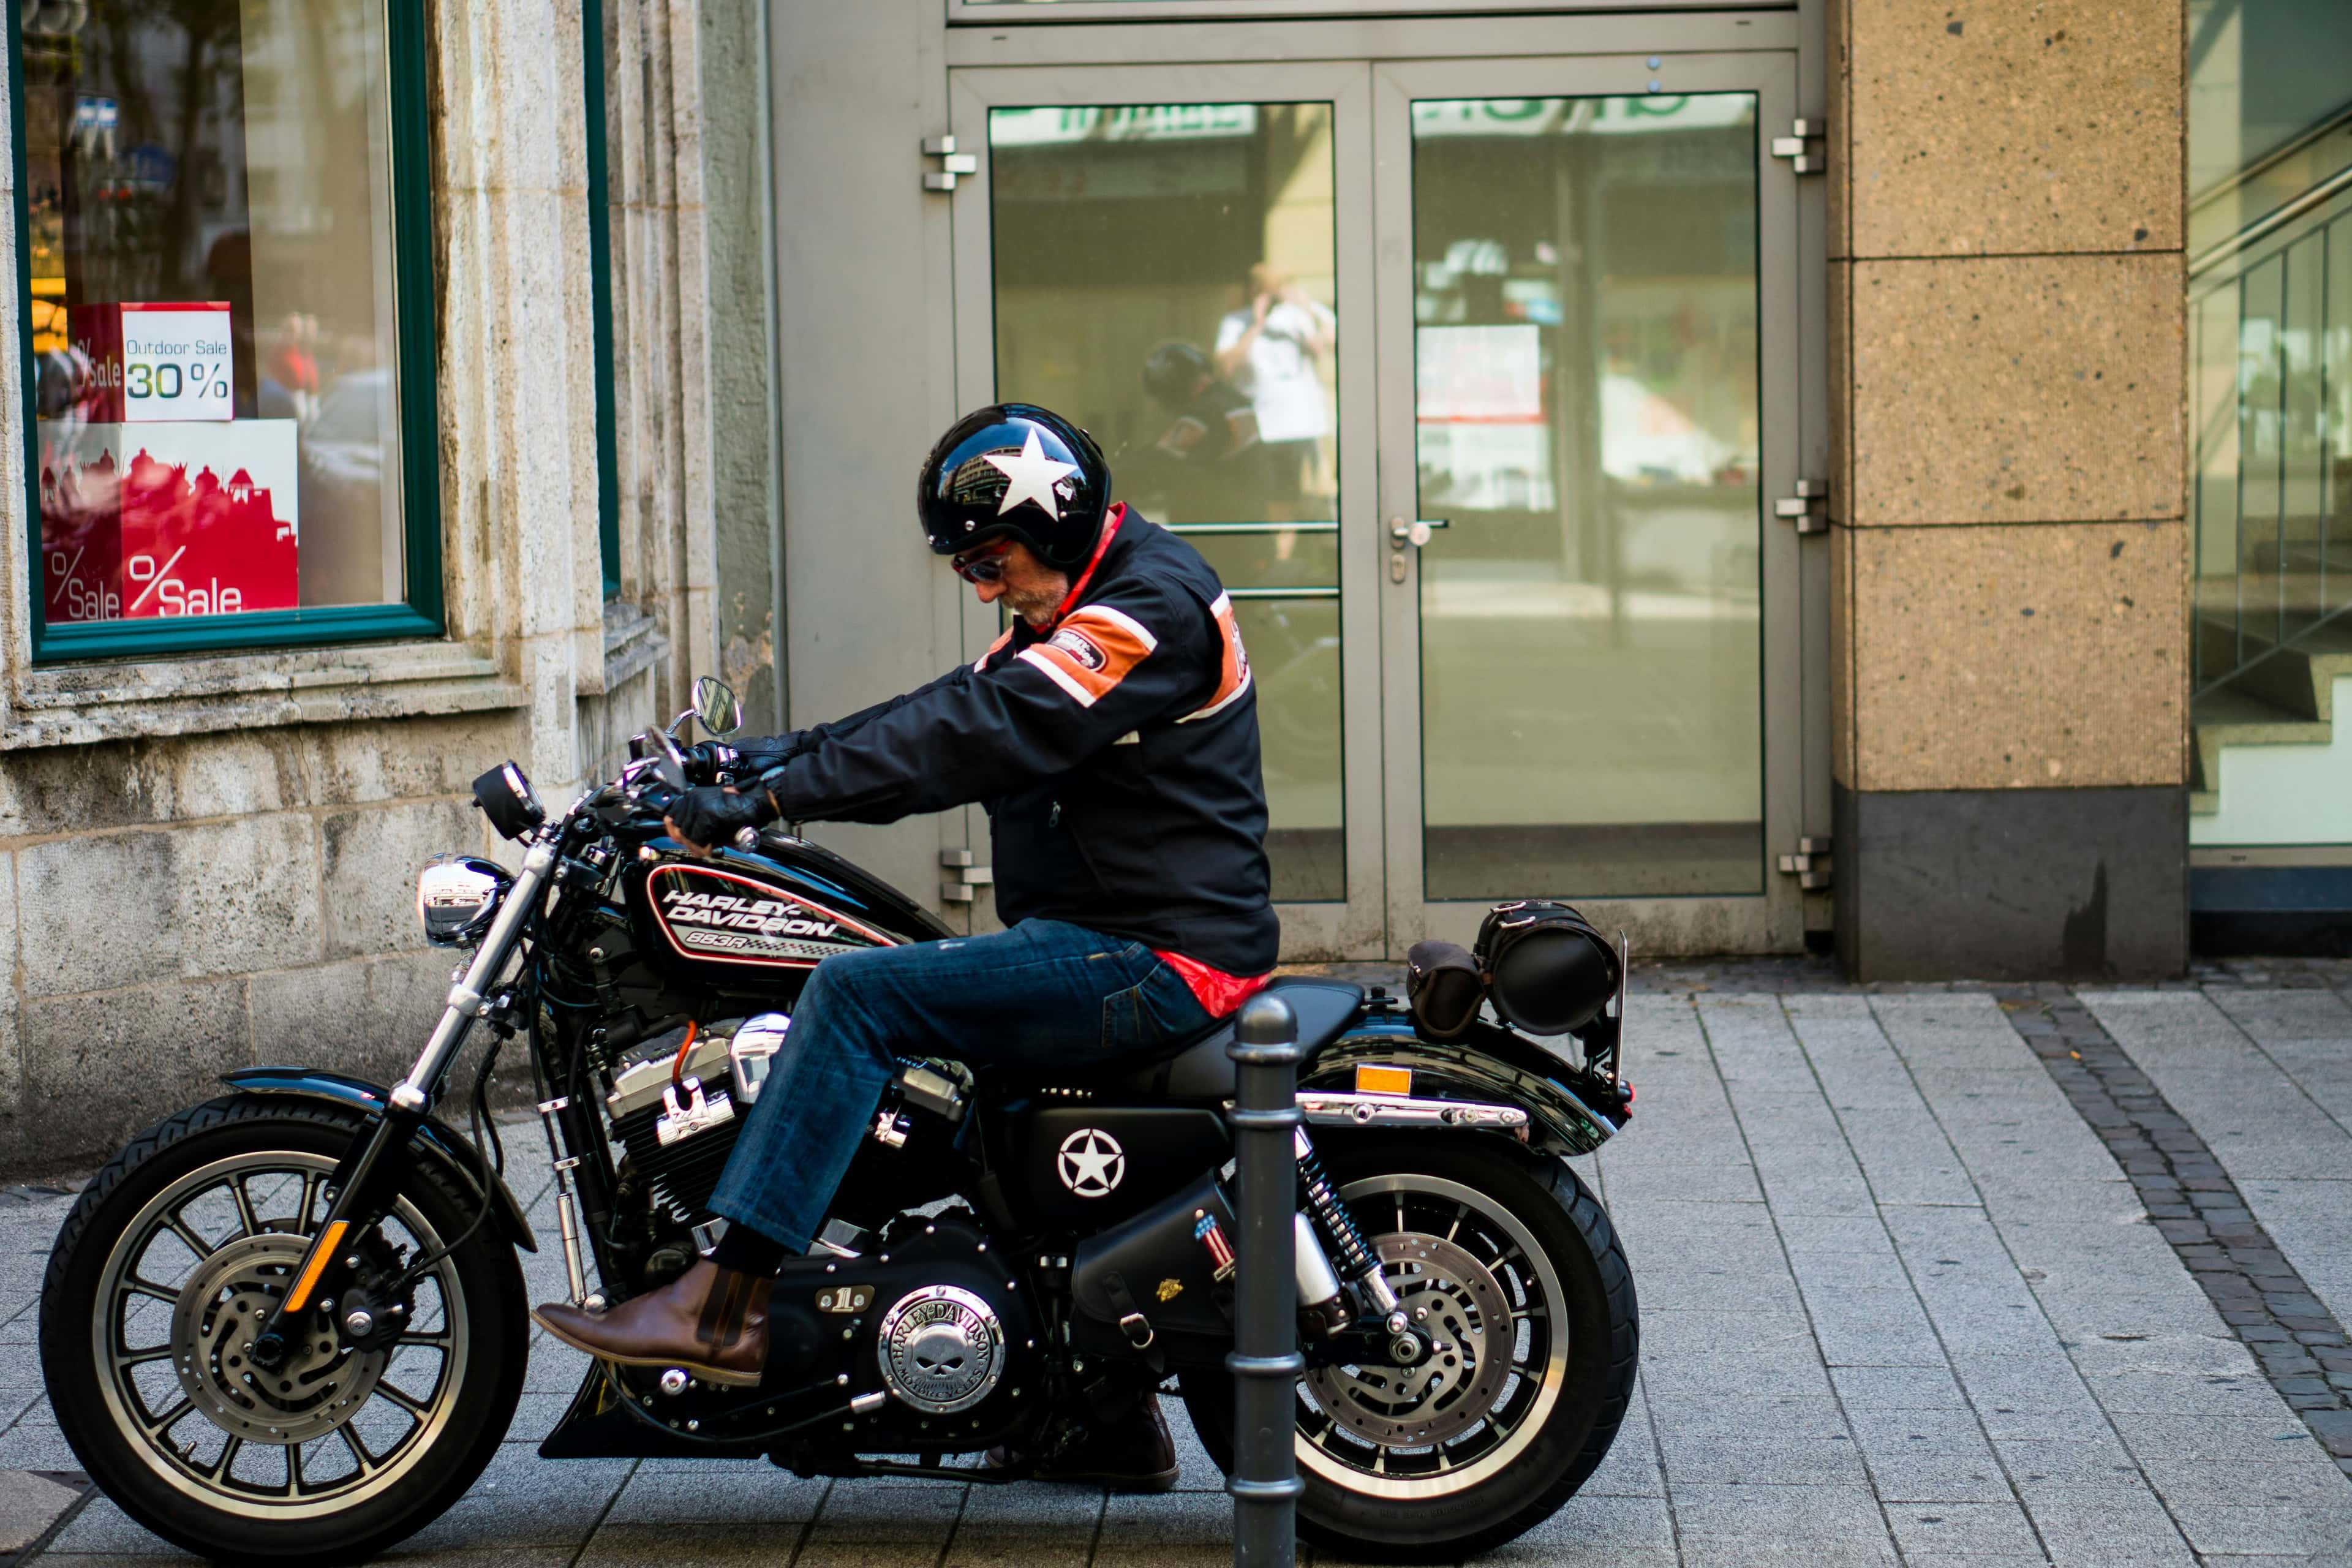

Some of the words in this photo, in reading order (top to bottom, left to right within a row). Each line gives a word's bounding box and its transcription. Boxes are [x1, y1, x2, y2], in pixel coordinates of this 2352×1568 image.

[127, 339, 190, 355] Outdoor
[195, 339, 227, 355] Sale
[89, 355, 121, 388] Sale
[69, 578, 119, 622] Sale
[159, 577, 242, 618] Sale
[663, 890, 802, 916] HARLEY-
[666, 905, 838, 938] DAVIDSON
[685, 930, 747, 949] 883R
[831, 1287, 854, 1313] 1
[898, 1366, 984, 1398] MOTORCYCLES
